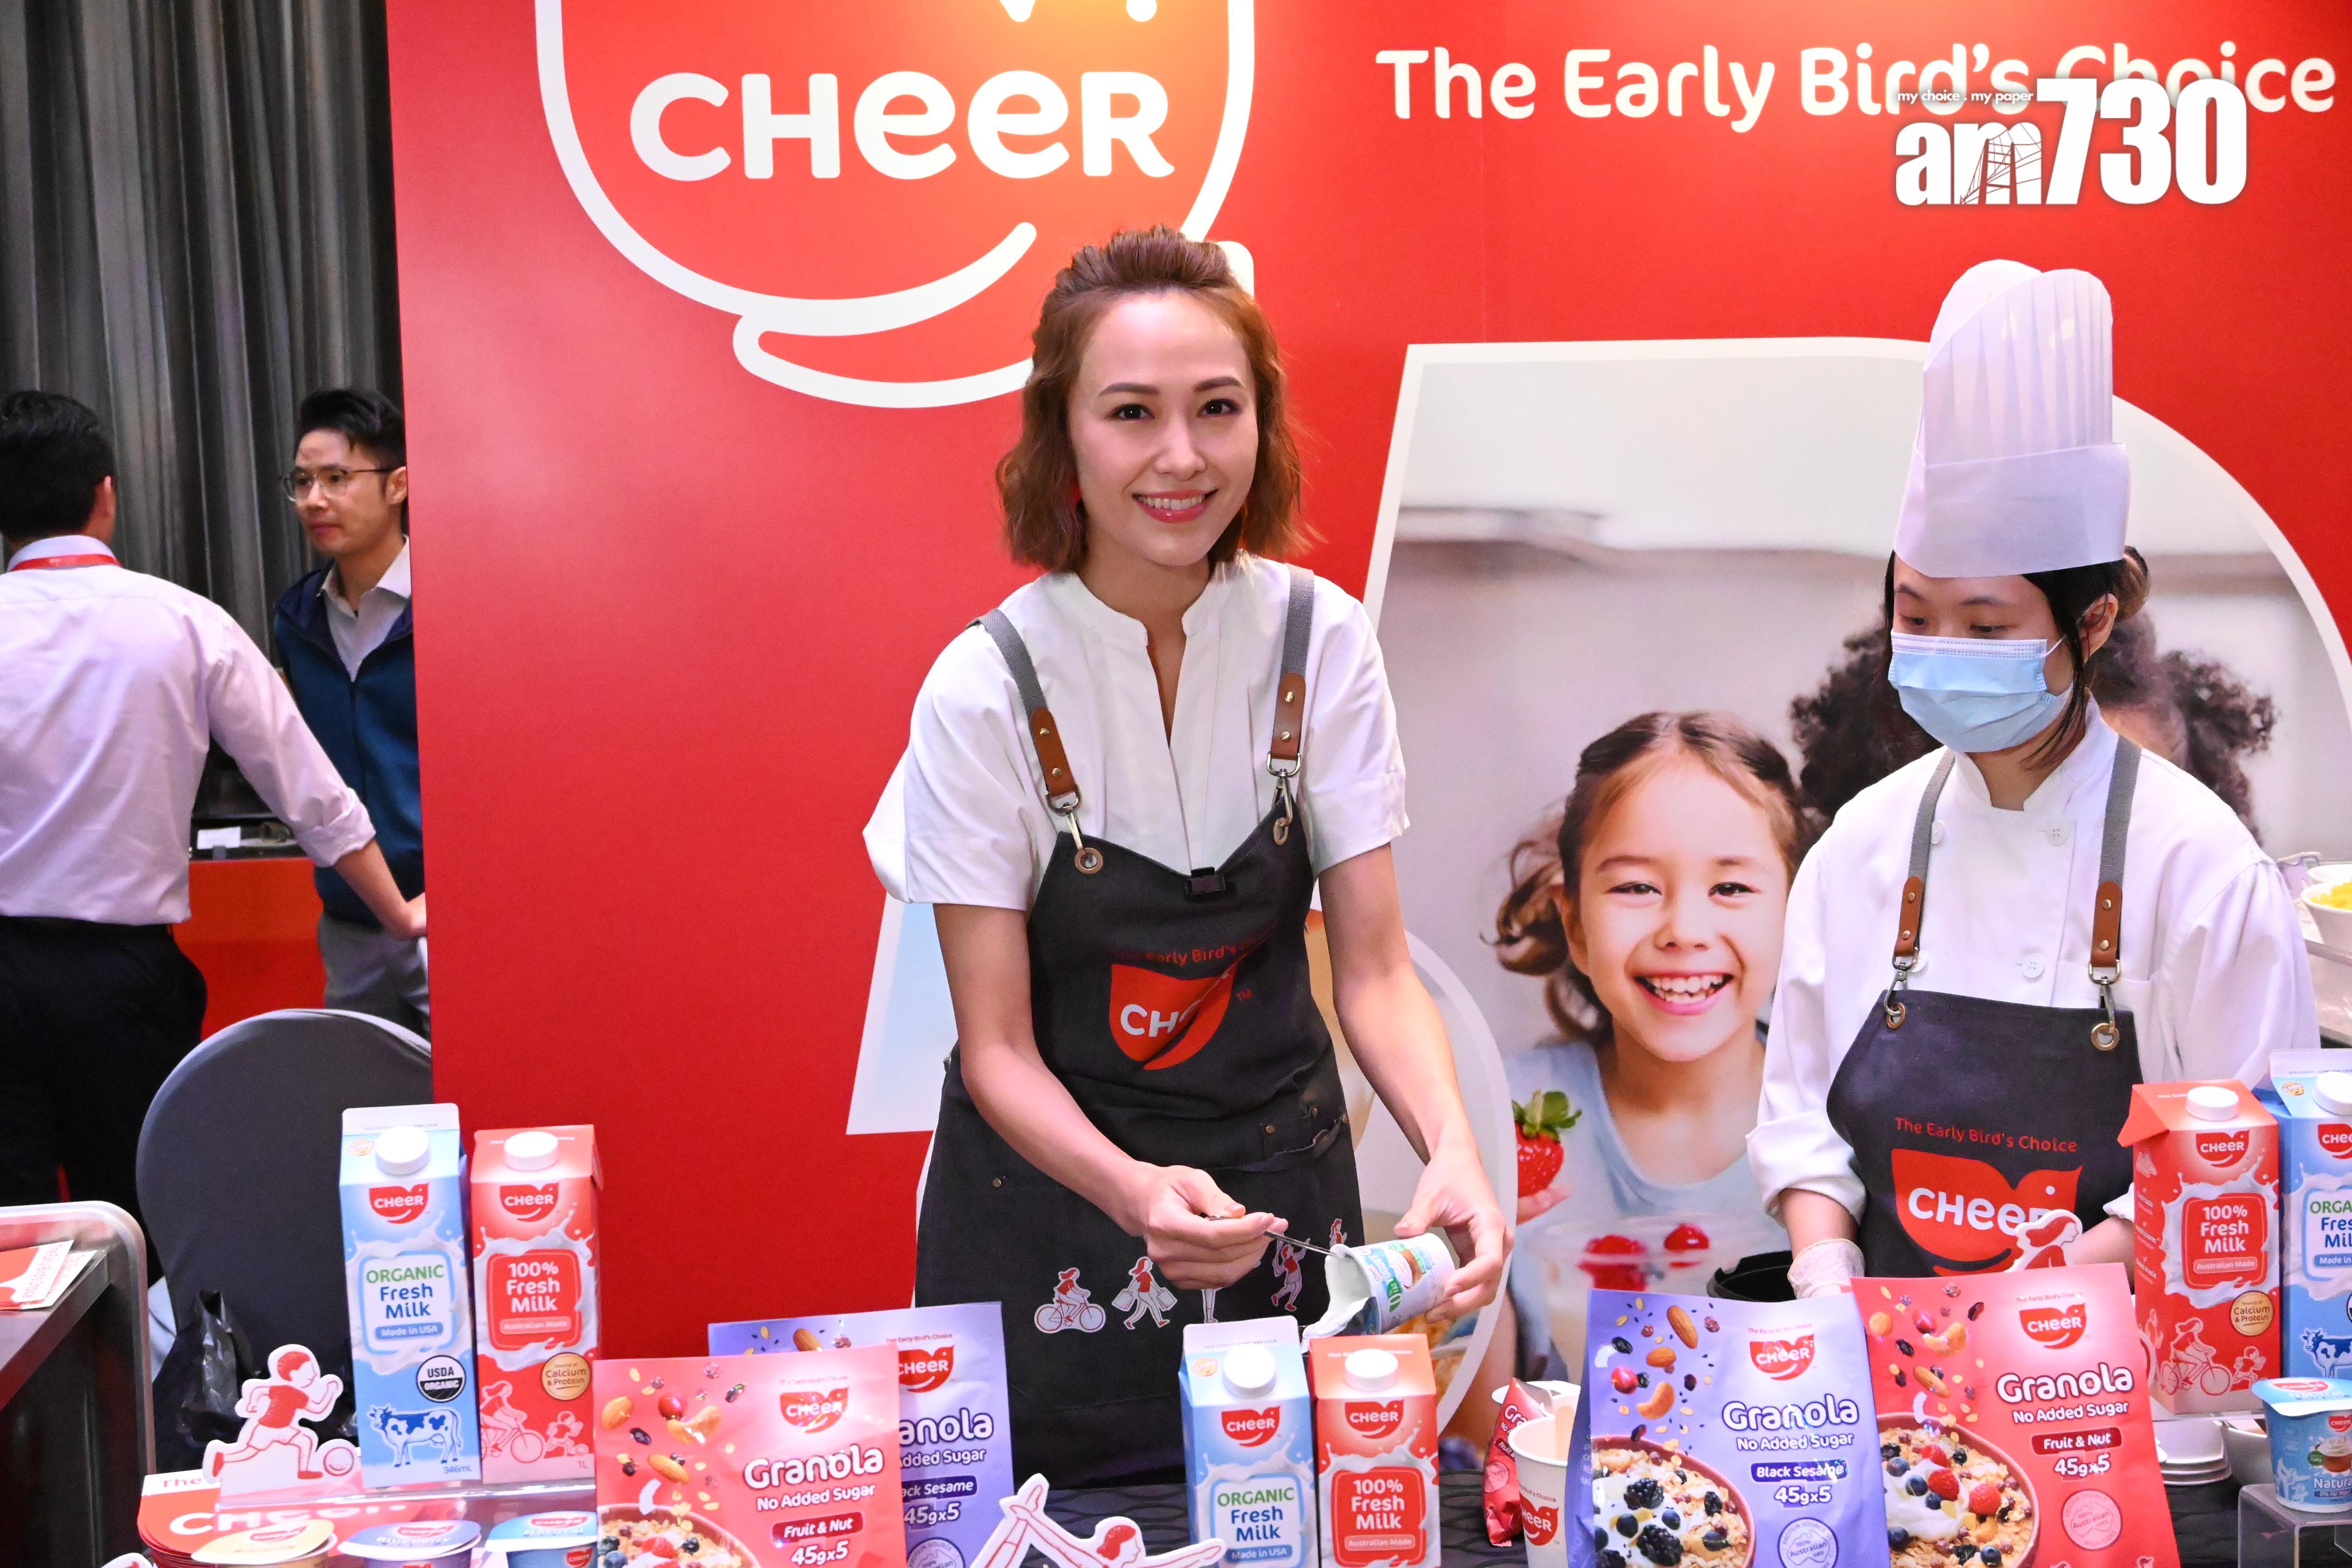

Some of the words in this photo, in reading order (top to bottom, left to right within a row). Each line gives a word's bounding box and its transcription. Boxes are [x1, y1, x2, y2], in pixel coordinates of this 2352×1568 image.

[1376, 47, 1536, 119] The
[1566, 46, 1774, 132] Early
[1801, 43, 2029, 115] Bird's
[1895, 1117, 1923, 1134] The
[1926, 1122, 1965, 1144] Early
[1969, 1128, 2014, 1148] Bird's
[2018, 1135, 2078, 1153] Choice
[2202, 1204, 2248, 1220] 100%
[2309, 1200, 2352, 1214] ORGA
[2200, 1219, 2249, 1236] Fresh
[2321, 1217, 2352, 1231] Fres
[2205, 1236, 2247, 1254] Milk
[2324, 1233, 2352, 1248] Mil
[366, 1264, 444, 1284] ORGANIC
[508, 1261, 560, 1278] 100%
[2196, 1262, 2234, 1270] Australian
[380, 1282, 433, 1302] Fresh
[506, 1277, 561, 1295] Fresh
[385, 1301, 431, 1319] Milk
[511, 1295, 559, 1313] Milk
[2233, 1306, 2270, 1315] Calcium
[418, 1324, 439, 1334] USA
[427, 1365, 455, 1378] USDA
[545, 1368, 587, 1379] Calcium
[424, 1379, 459, 1391] ORGANIC
[554, 1377, 585, 1386] Protein
[1996, 1362, 2135, 1404] Granola
[1722, 1393, 1860, 1432] Granola
[2012, 1410, 2034, 1424] No
[2036, 1404, 2084, 1423] Added
[2086, 1401, 2129, 1417] Sugar
[899, 1407, 994, 1447] anola
[1500, 1421, 1508, 1432] No
[1498, 1441, 1511, 1455] Fruit
[1736, 1437, 1758, 1451] No
[1759, 1435, 1809, 1451] Added
[1810, 1433, 1854, 1450] Sugar
[2043, 1437, 2073, 1450] Fruit
[2075, 1436, 2085, 1447] &
[2087, 1433, 2111, 1446] Nut
[743, 1443, 885, 1490] Granola
[900, 1450, 940, 1469] dded
[943, 1449, 987, 1466] Sugar
[1756, 1466, 1791, 1478] Black
[1793, 1463, 1844, 1479] Sesame
[159, 1478, 202, 1489] The
[923, 1481, 974, 1495] Sesame
[1352, 1478, 1404, 1495] 100%
[2313, 1477, 2352, 1489] Natura
[757, 1496, 779, 1512] No
[780, 1489, 831, 1508] Added
[832, 1484, 876, 1501] Sugar
[1217, 1487, 1295, 1507] ORGANIC
[1351, 1494, 1405, 1512] Fresh
[1537, 1493, 1557, 1503] Choice
[1231, 1505, 1283, 1524] Fresh
[1357, 1512, 1402, 1530] Milk
[2072, 1511, 2110, 1529] Australian
[784, 1523, 815, 1538] Fruit
[817, 1521, 828, 1534] &
[829, 1517, 854, 1532] Nut
[1236, 1523, 1281, 1542] Milk
[1348, 1539, 1389, 1547] Australian
[1789, 1541, 1827, 1557] Australian
[1231, 1551, 1257, 1560] Made
[1268, 1547, 1287, 1557] USA
